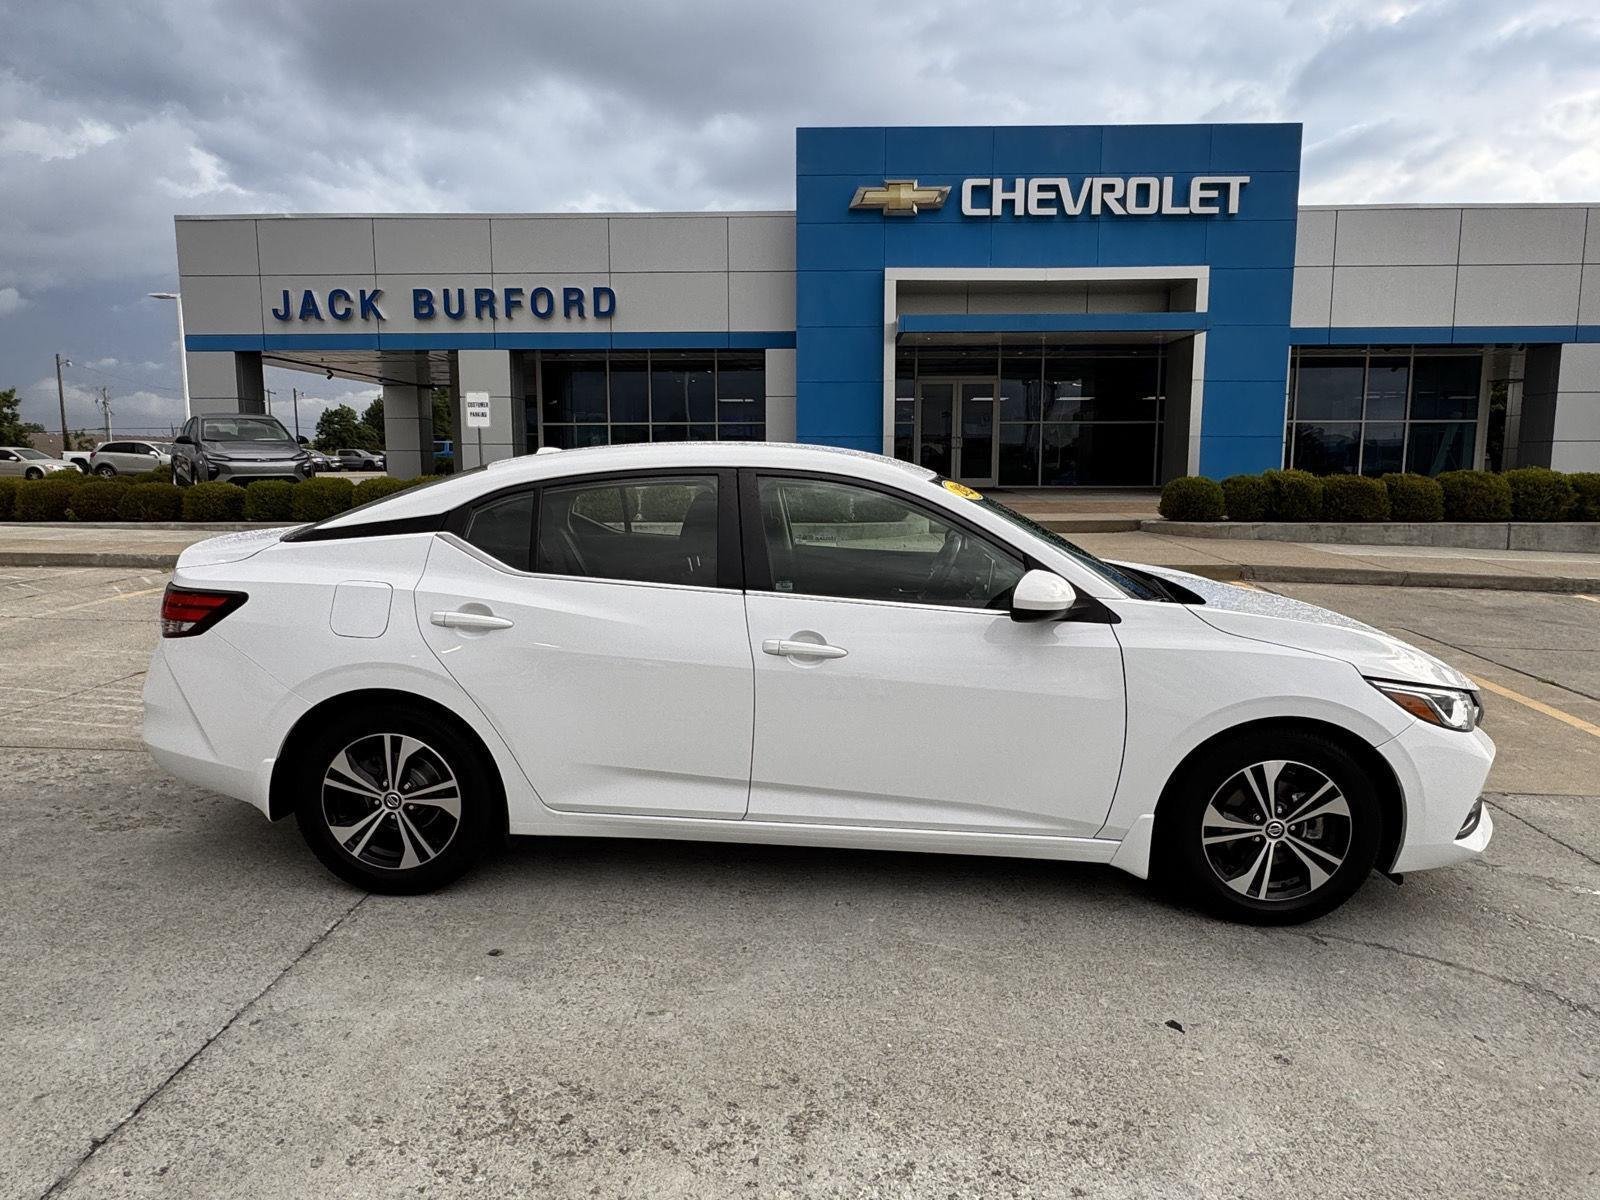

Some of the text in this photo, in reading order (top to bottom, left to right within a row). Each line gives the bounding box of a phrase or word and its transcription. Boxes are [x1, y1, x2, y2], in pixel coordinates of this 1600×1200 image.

[961, 176, 1251, 217] CHEVROLET
[272, 287, 617, 321] JACK BURFORD
